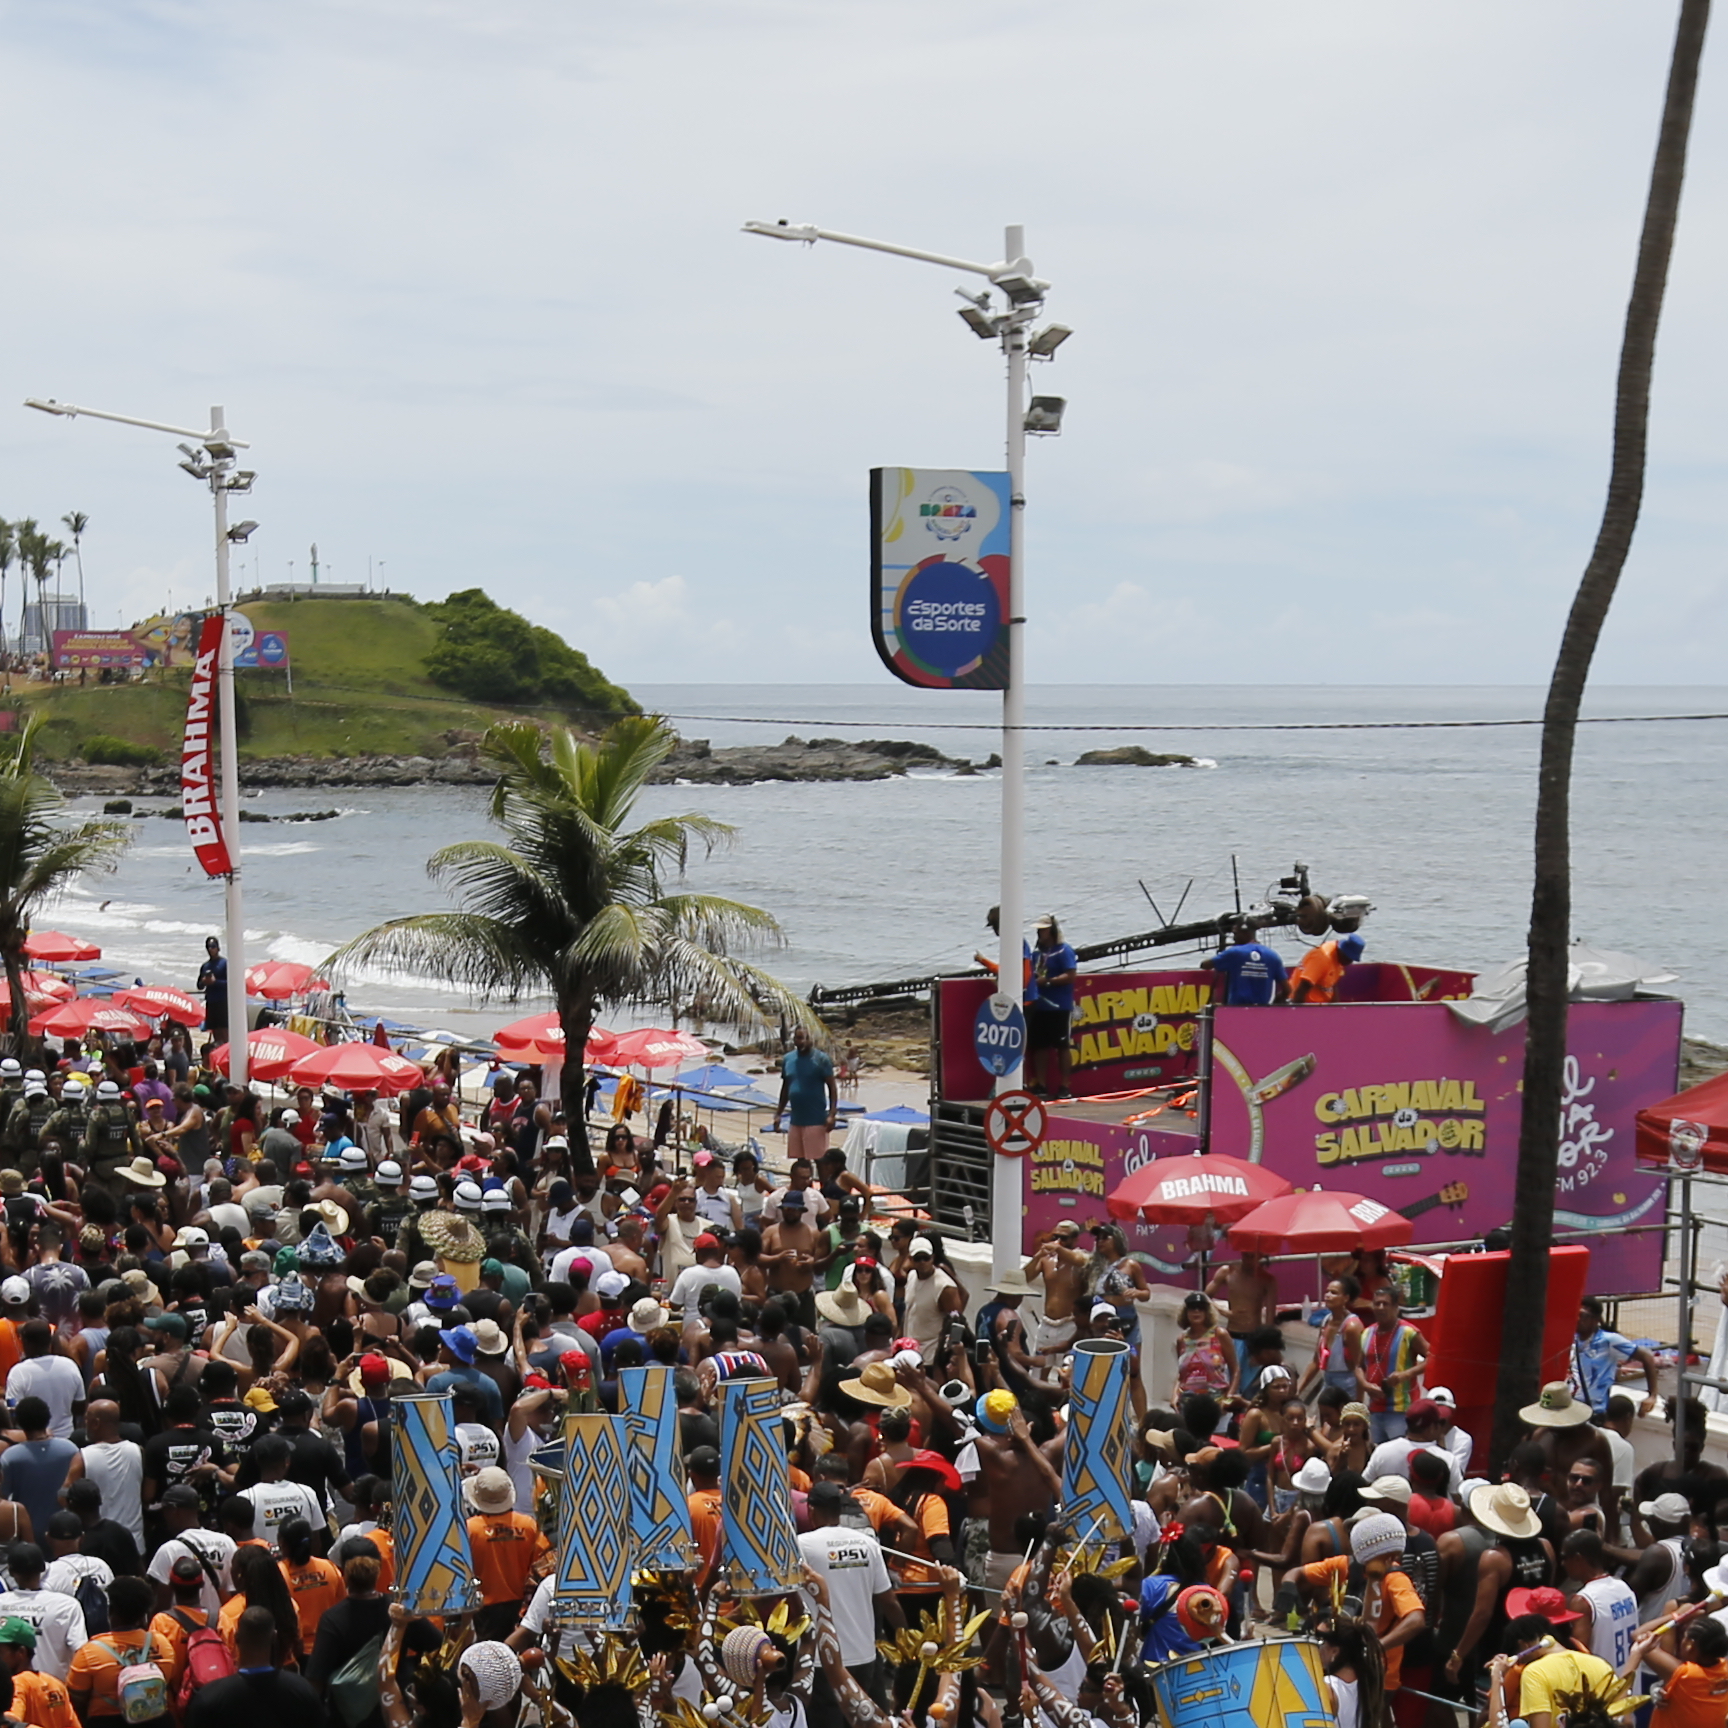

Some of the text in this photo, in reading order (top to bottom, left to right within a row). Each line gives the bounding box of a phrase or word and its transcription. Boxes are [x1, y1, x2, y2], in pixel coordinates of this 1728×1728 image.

[907, 601, 986, 619] Esportes
[183, 648, 216, 848] BRAHMA
[146, 990, 193, 1013] BRAHMA
[977, 1021, 1022, 1049] 207D
[1315, 1080, 1485, 1123] CARNAVAL
[1315, 1118, 1485, 1165] SALVADOR
[1577, 1149, 1609, 1186] 92.3
[1160, 1173, 1249, 1200] BRAHMA
[273, 1505, 304, 1519] PSV
[838, 1549, 869, 1561] PSV
